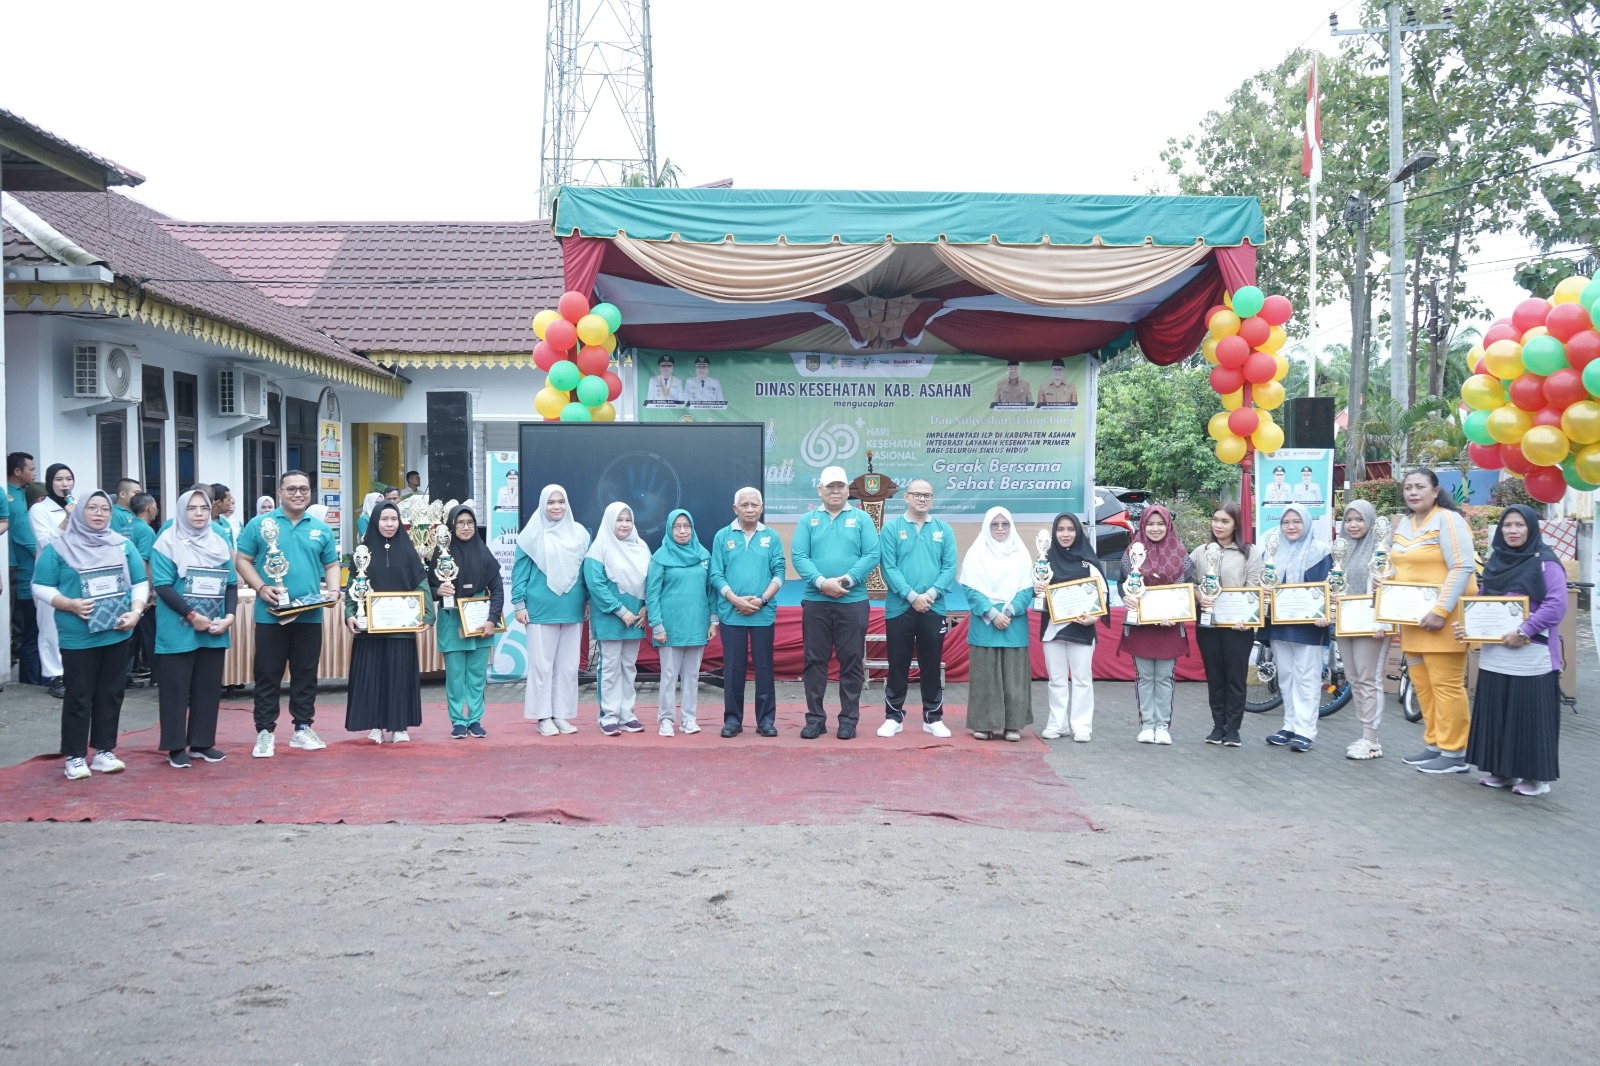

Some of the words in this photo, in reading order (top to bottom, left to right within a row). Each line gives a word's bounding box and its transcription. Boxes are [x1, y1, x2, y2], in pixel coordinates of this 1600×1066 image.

[755, 382, 795, 396] DINAS
[799, 382, 876, 397] KESEHATAN
[884, 383, 915, 397] KAB.
[919, 383, 971, 398] ASAHAN
[833, 399, 895, 409] mengucapkan
[866, 428, 890, 436] HARI
[866, 440, 921, 448] KESEHATAN
[866, 451, 916, 460] ASIONAL
[932, 458, 985, 473] Gerak
[989, 458, 1061, 473] Bersama
[946, 476, 995, 490] Sehat
[999, 476, 1072, 490] Bersama
